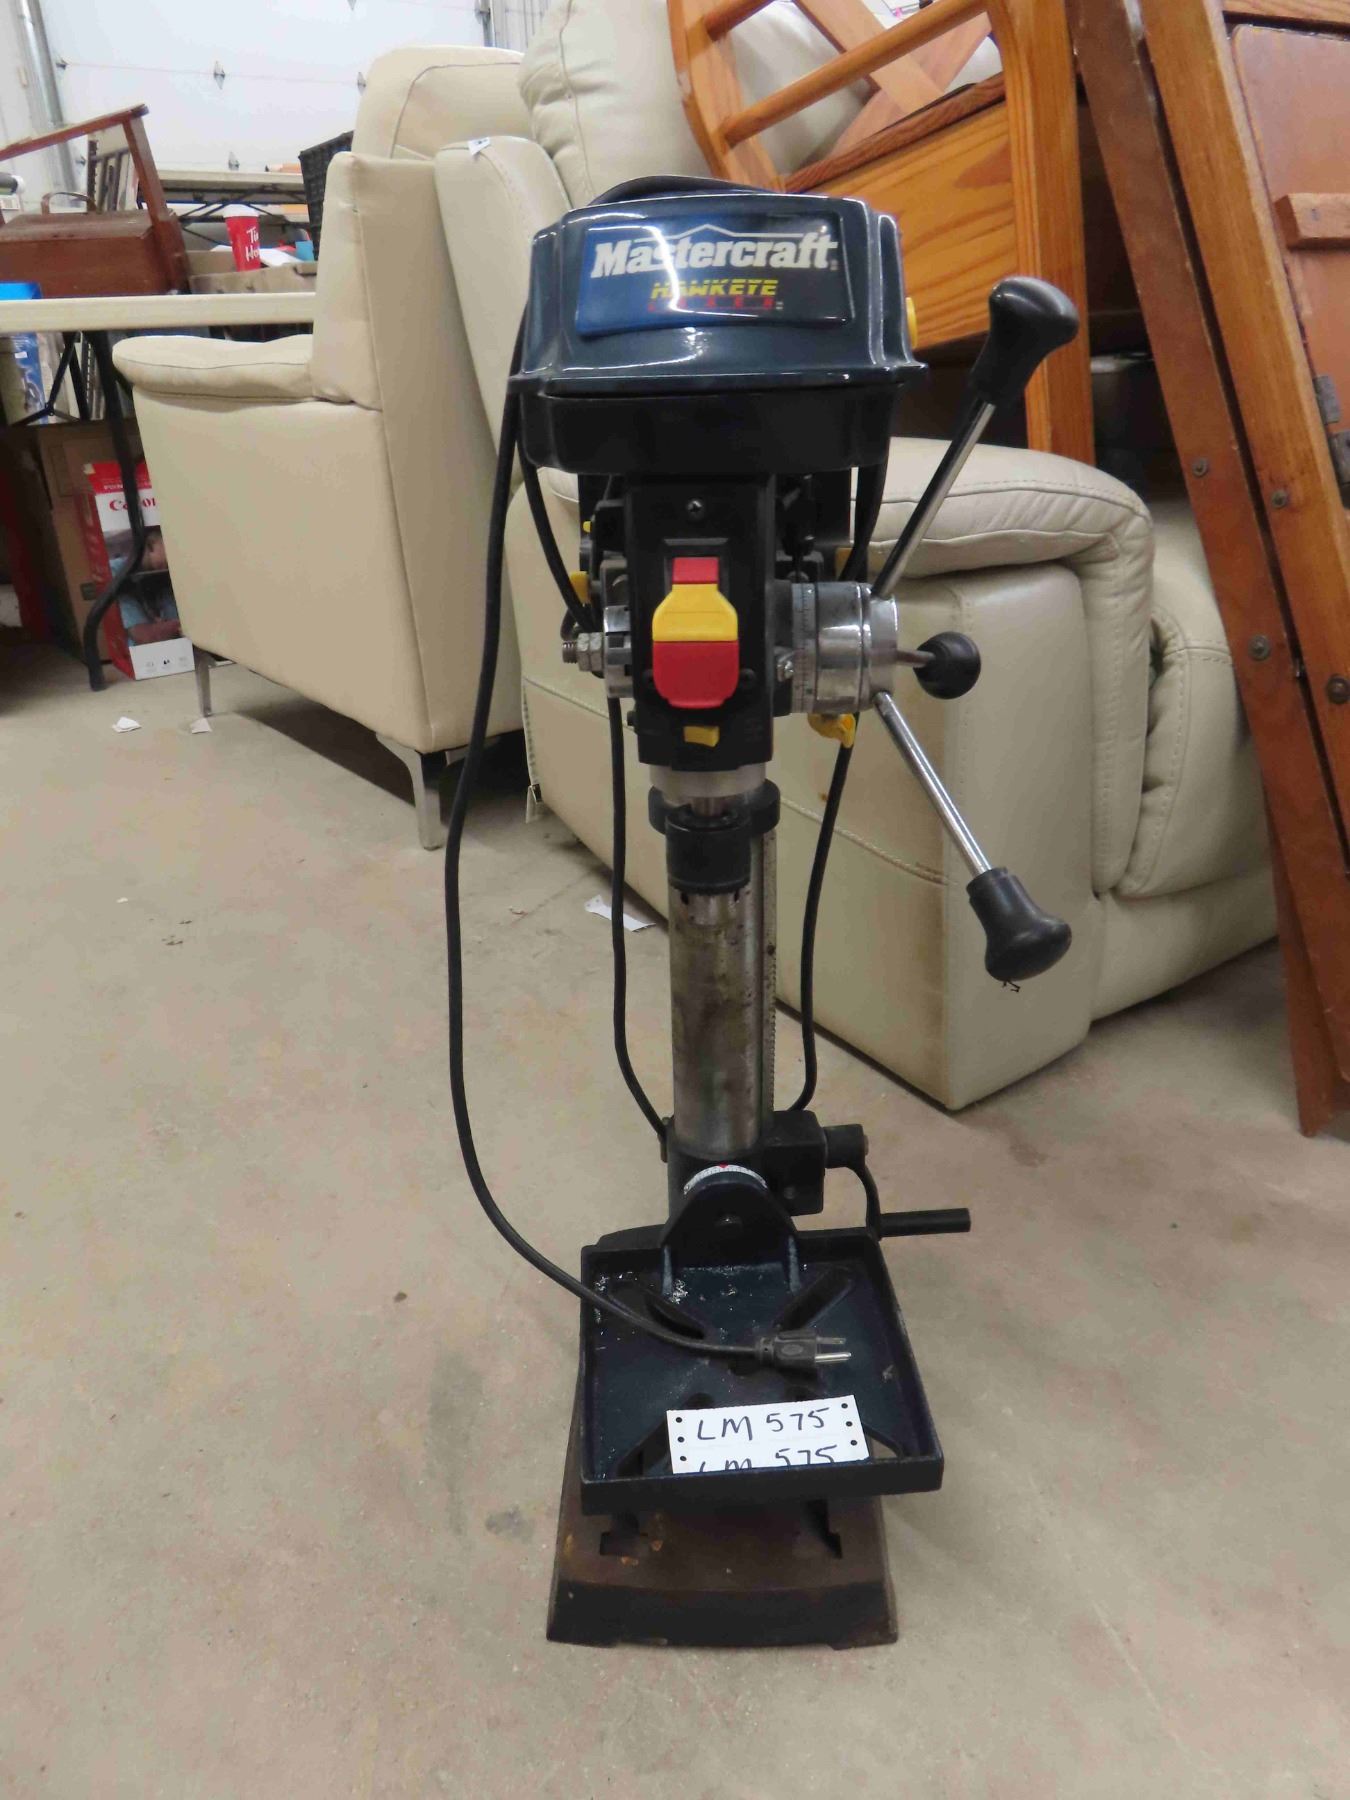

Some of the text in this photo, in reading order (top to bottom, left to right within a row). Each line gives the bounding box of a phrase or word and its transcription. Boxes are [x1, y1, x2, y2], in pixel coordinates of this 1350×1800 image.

[590, 232, 839, 278] Mastercraft
[697, 1407, 830, 1441] LM 575
